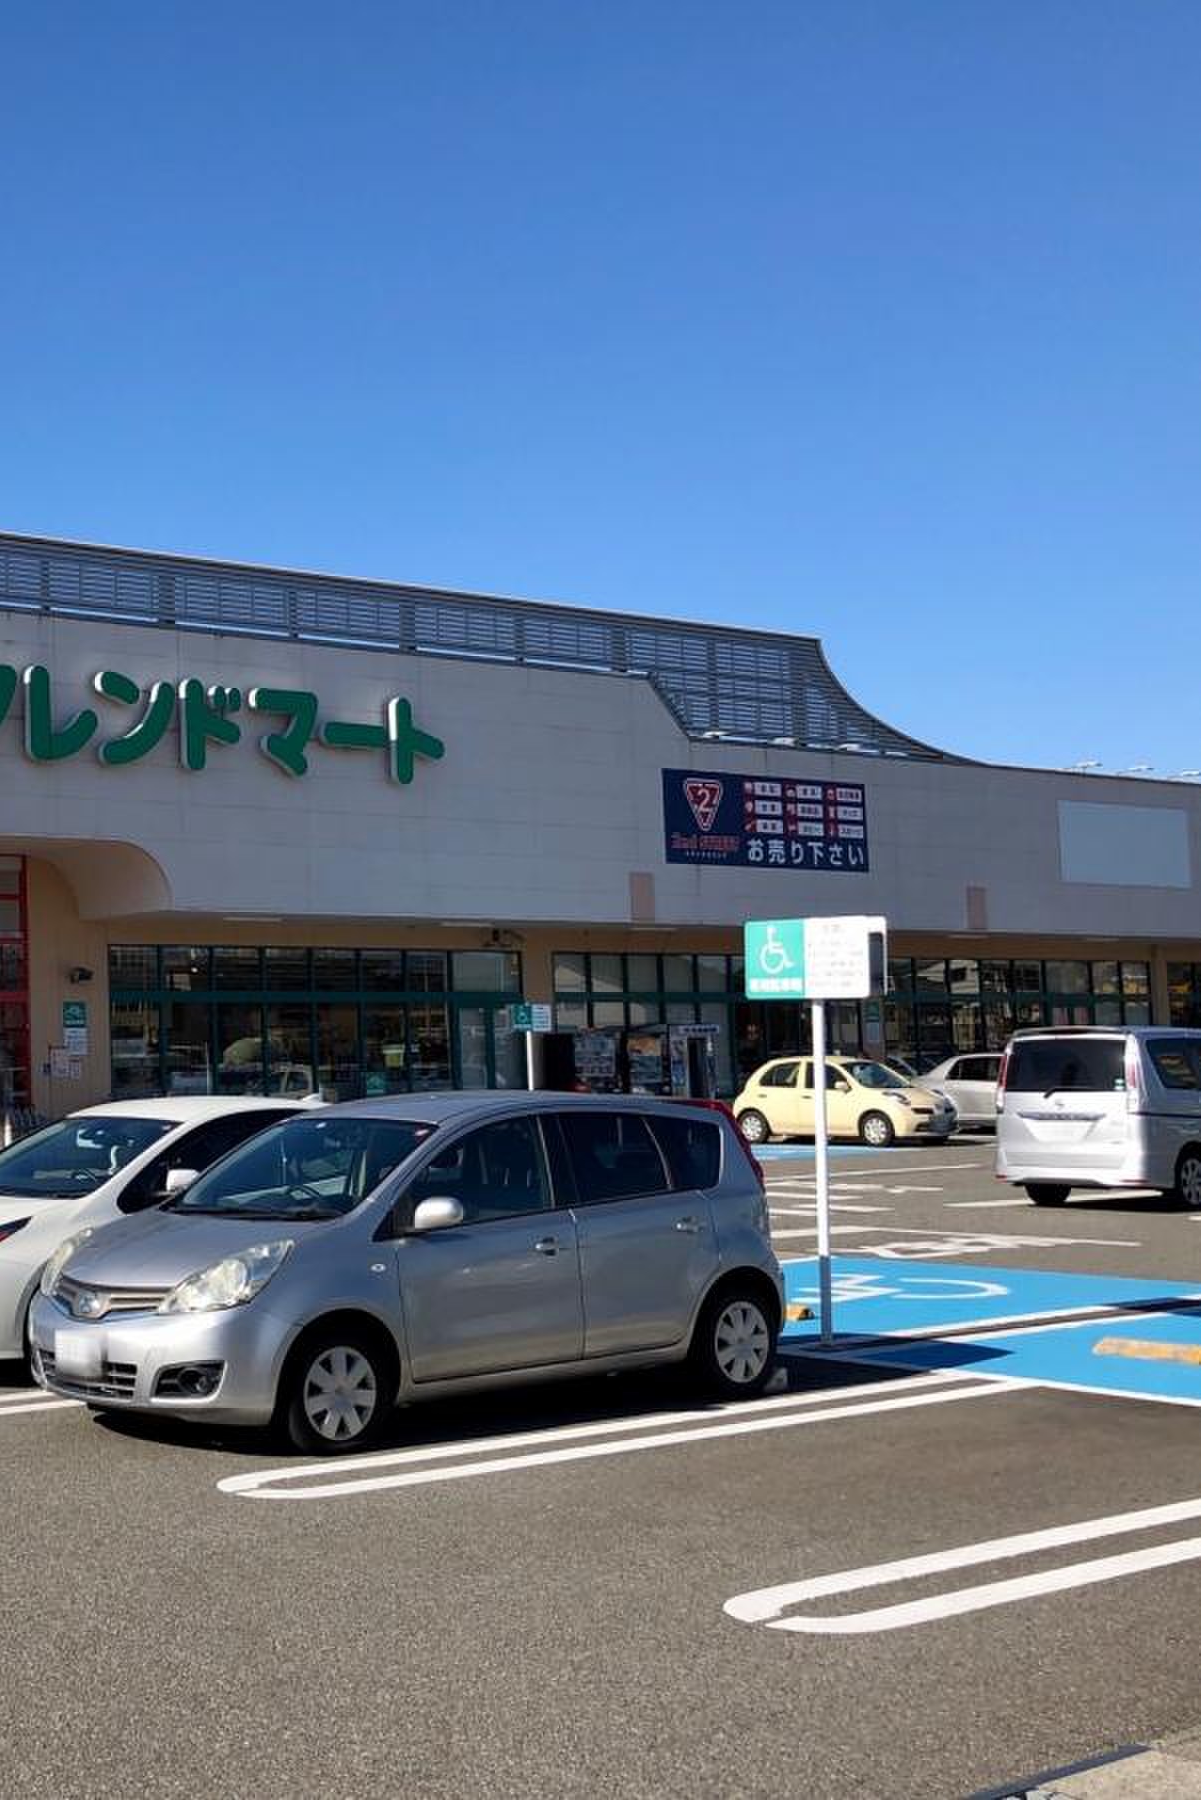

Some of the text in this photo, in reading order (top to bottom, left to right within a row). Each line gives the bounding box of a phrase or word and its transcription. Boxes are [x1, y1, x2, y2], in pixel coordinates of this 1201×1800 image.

[747, 840, 864, 865] お売り下さい
